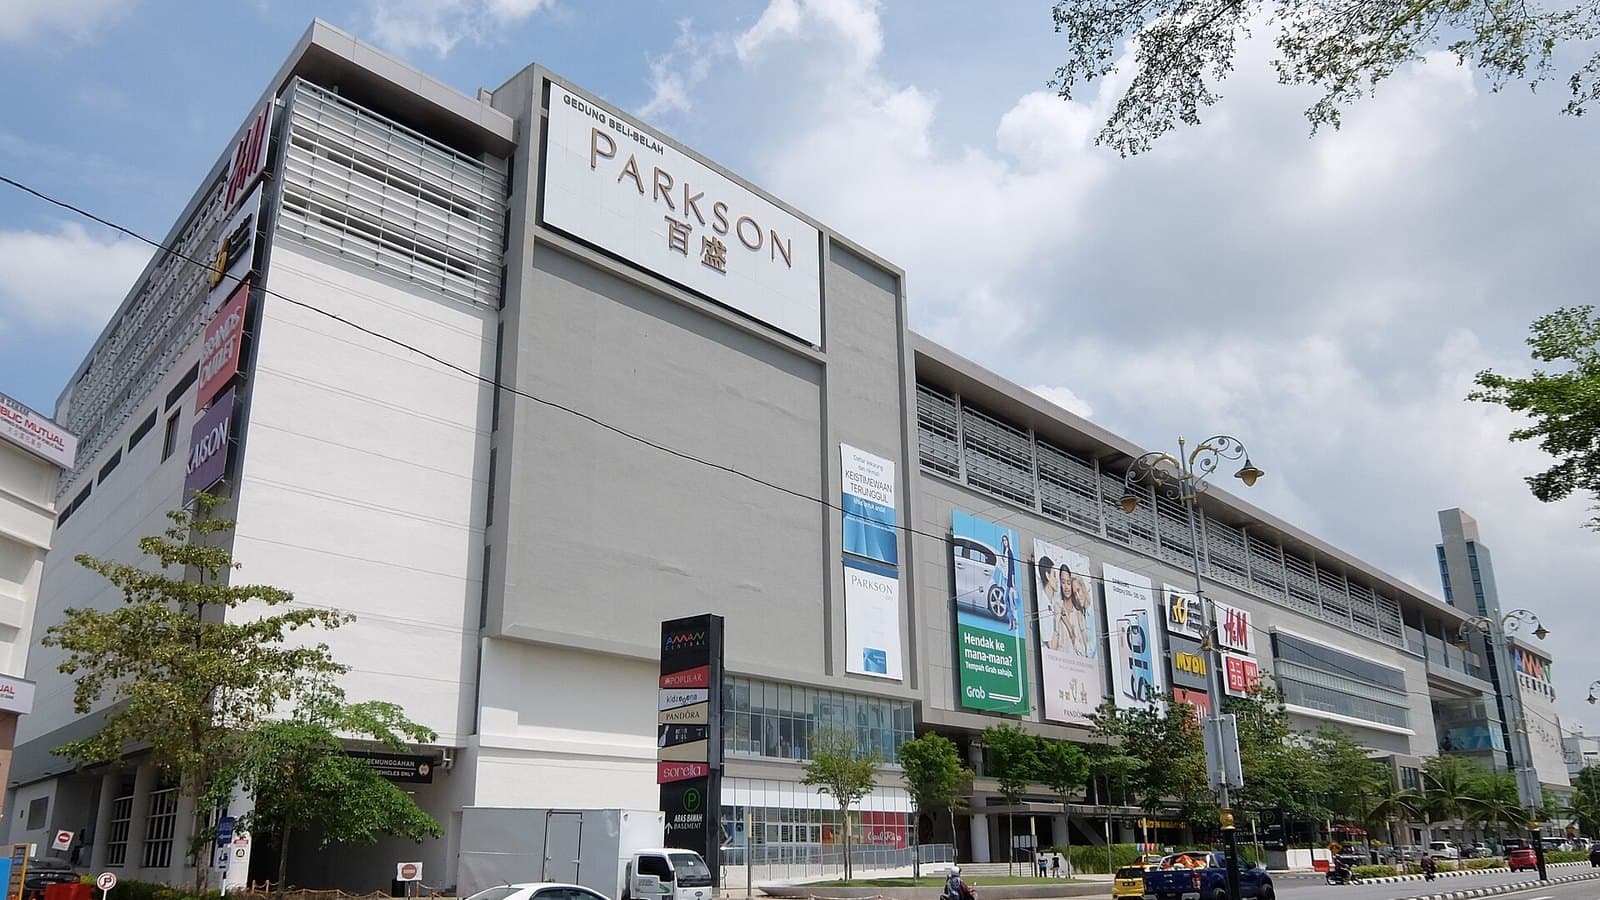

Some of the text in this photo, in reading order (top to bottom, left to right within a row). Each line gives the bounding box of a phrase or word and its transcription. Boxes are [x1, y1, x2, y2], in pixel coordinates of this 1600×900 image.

[563, 94, 664, 155] GEDUNG BELI-BELAH
[590, 127, 792, 268] PARKSON
[664, 215, 727, 274] 百盛
[24, 419, 65, 447] MUTUAL
[845, 470, 893, 493] KEISTIMEWAAN
[850, 482, 889, 504] TERUNGGUL
[851, 574, 894, 594] PARKSON
[1223, 607, 1248, 650] H&M
[963, 631, 1005, 652] Hendak ke
[964, 648, 1013, 667] mana-mana?
[965, 661, 985, 673] Tempah
[985, 665, 997, 674] Grab
[966, 685, 986, 699] Grab
[673, 822, 702, 830] BASEMENT
[674, 814, 687, 823] ARAS
